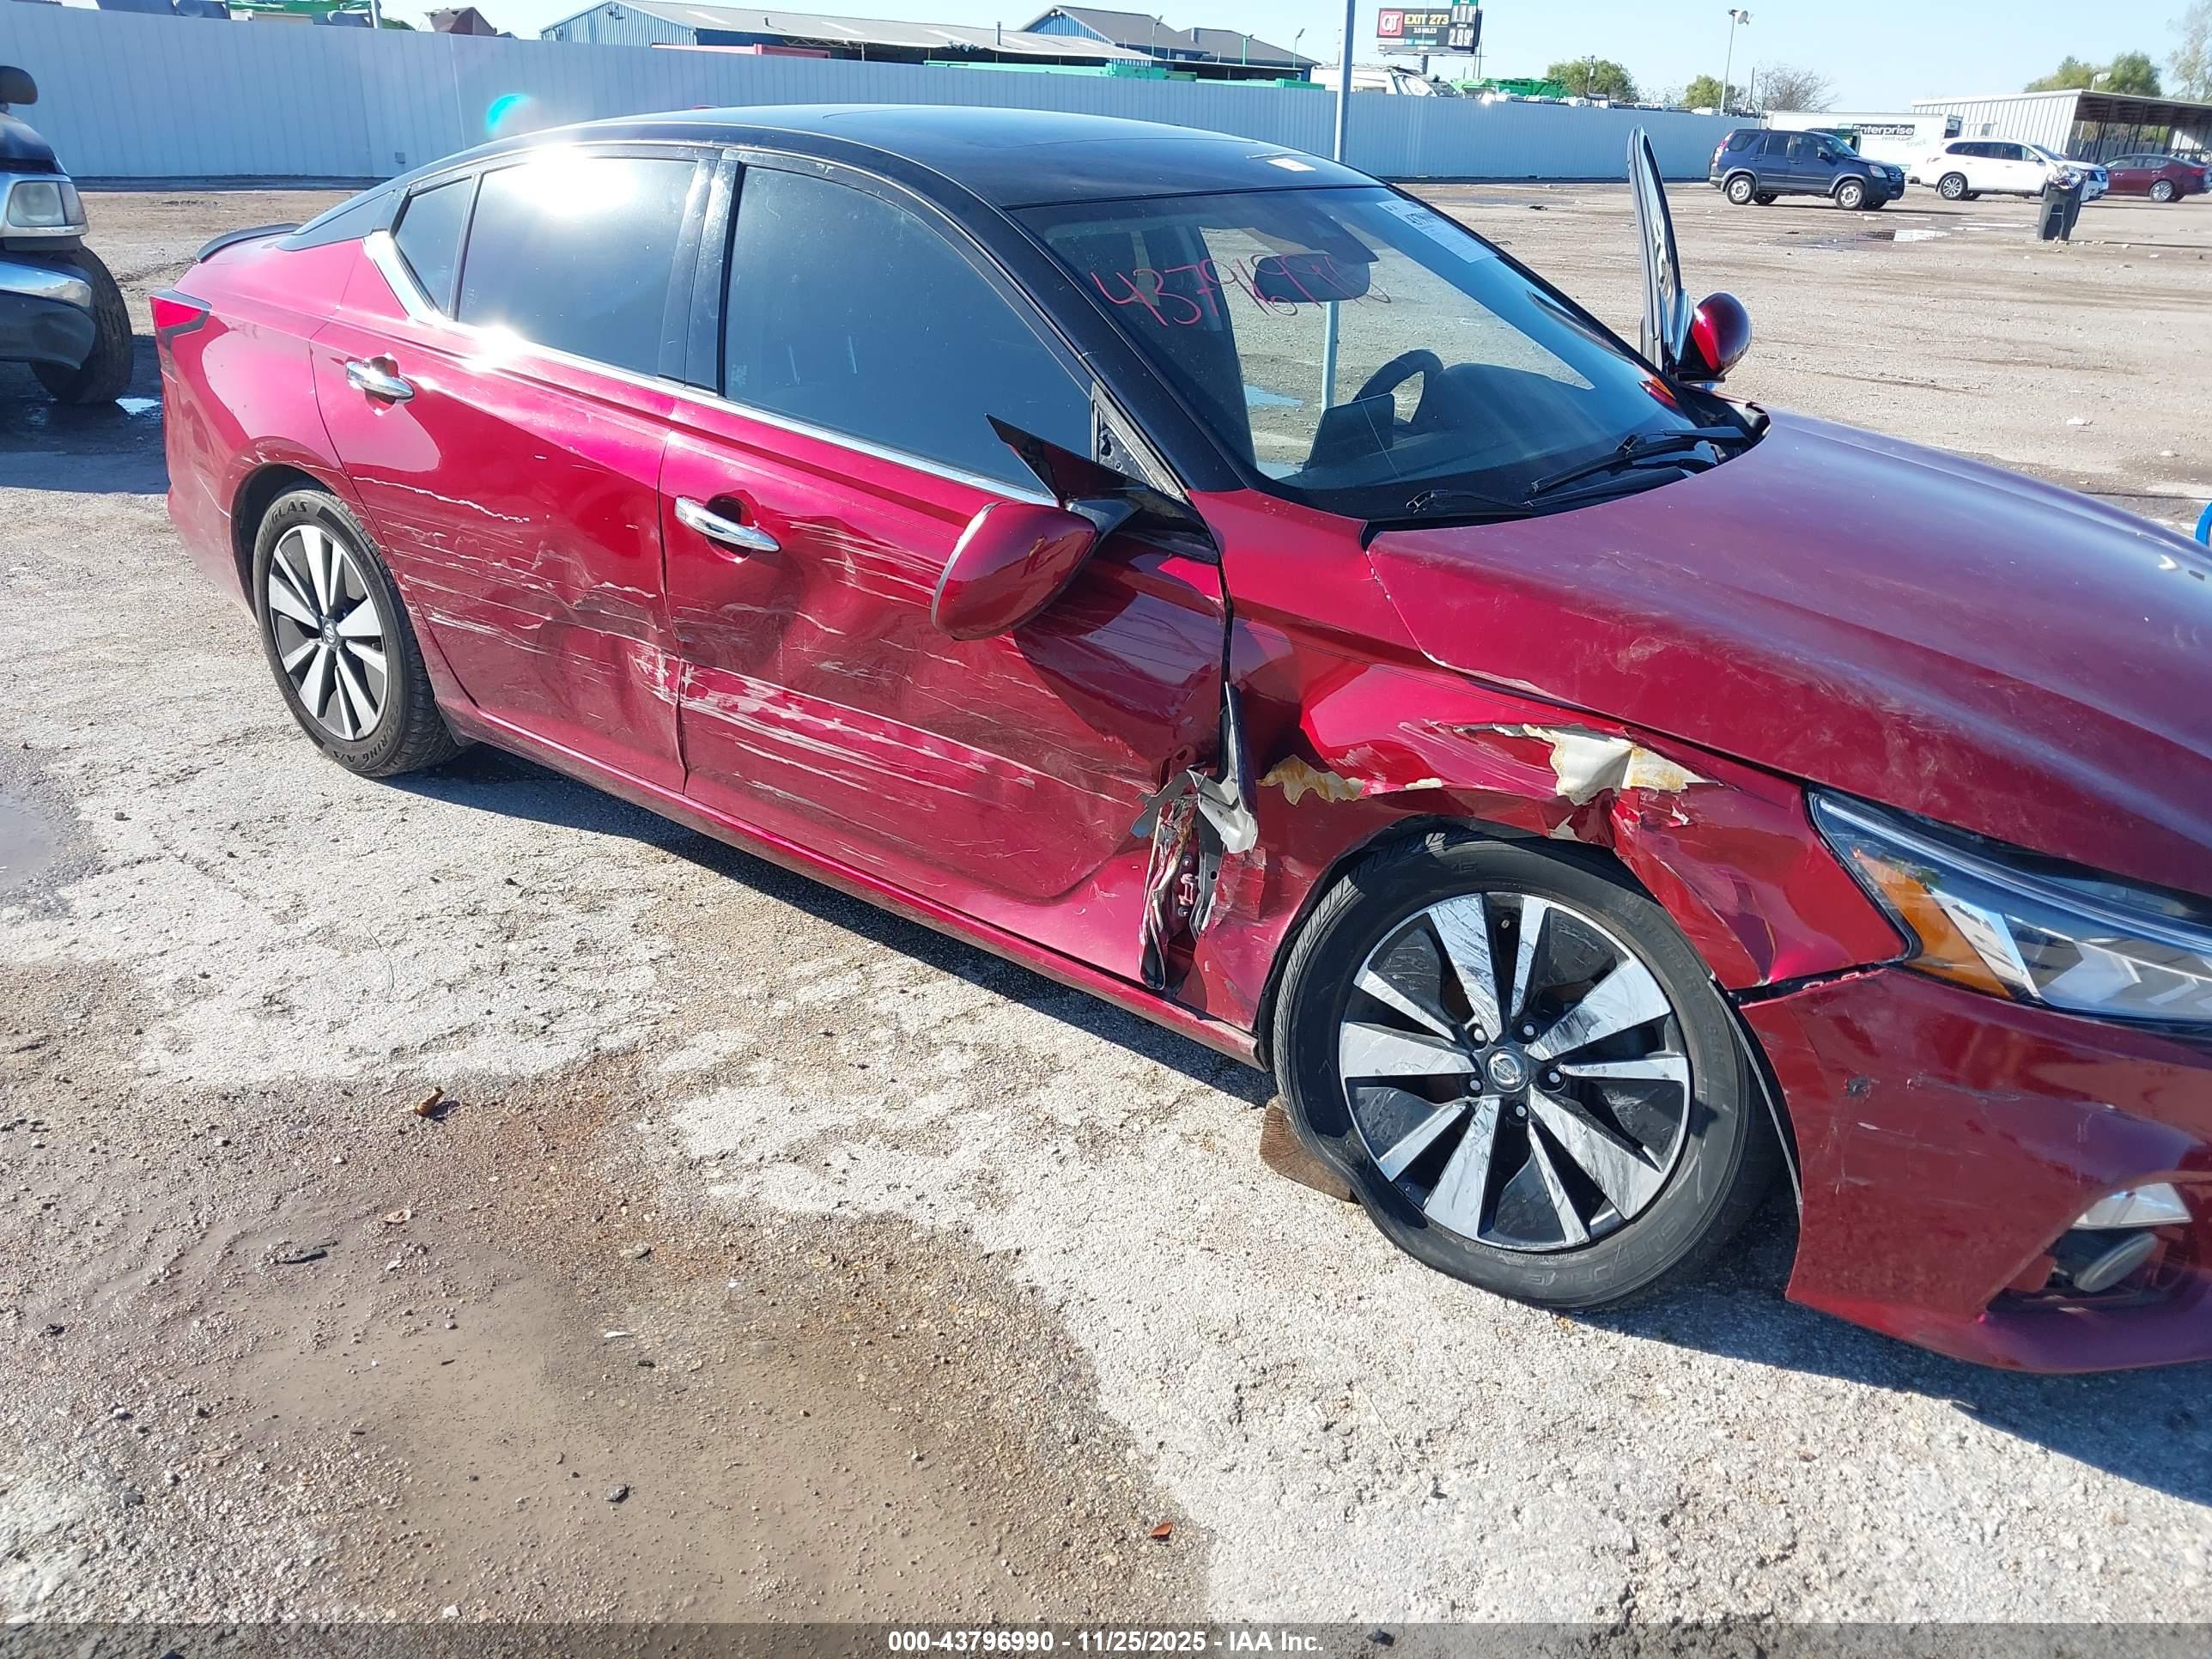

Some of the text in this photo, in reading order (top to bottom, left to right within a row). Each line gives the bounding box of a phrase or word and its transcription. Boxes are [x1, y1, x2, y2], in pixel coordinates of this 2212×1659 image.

[1404, 14, 1449, 25] EXIT 273
[1493, 1060, 1518, 1079] NISSAN
